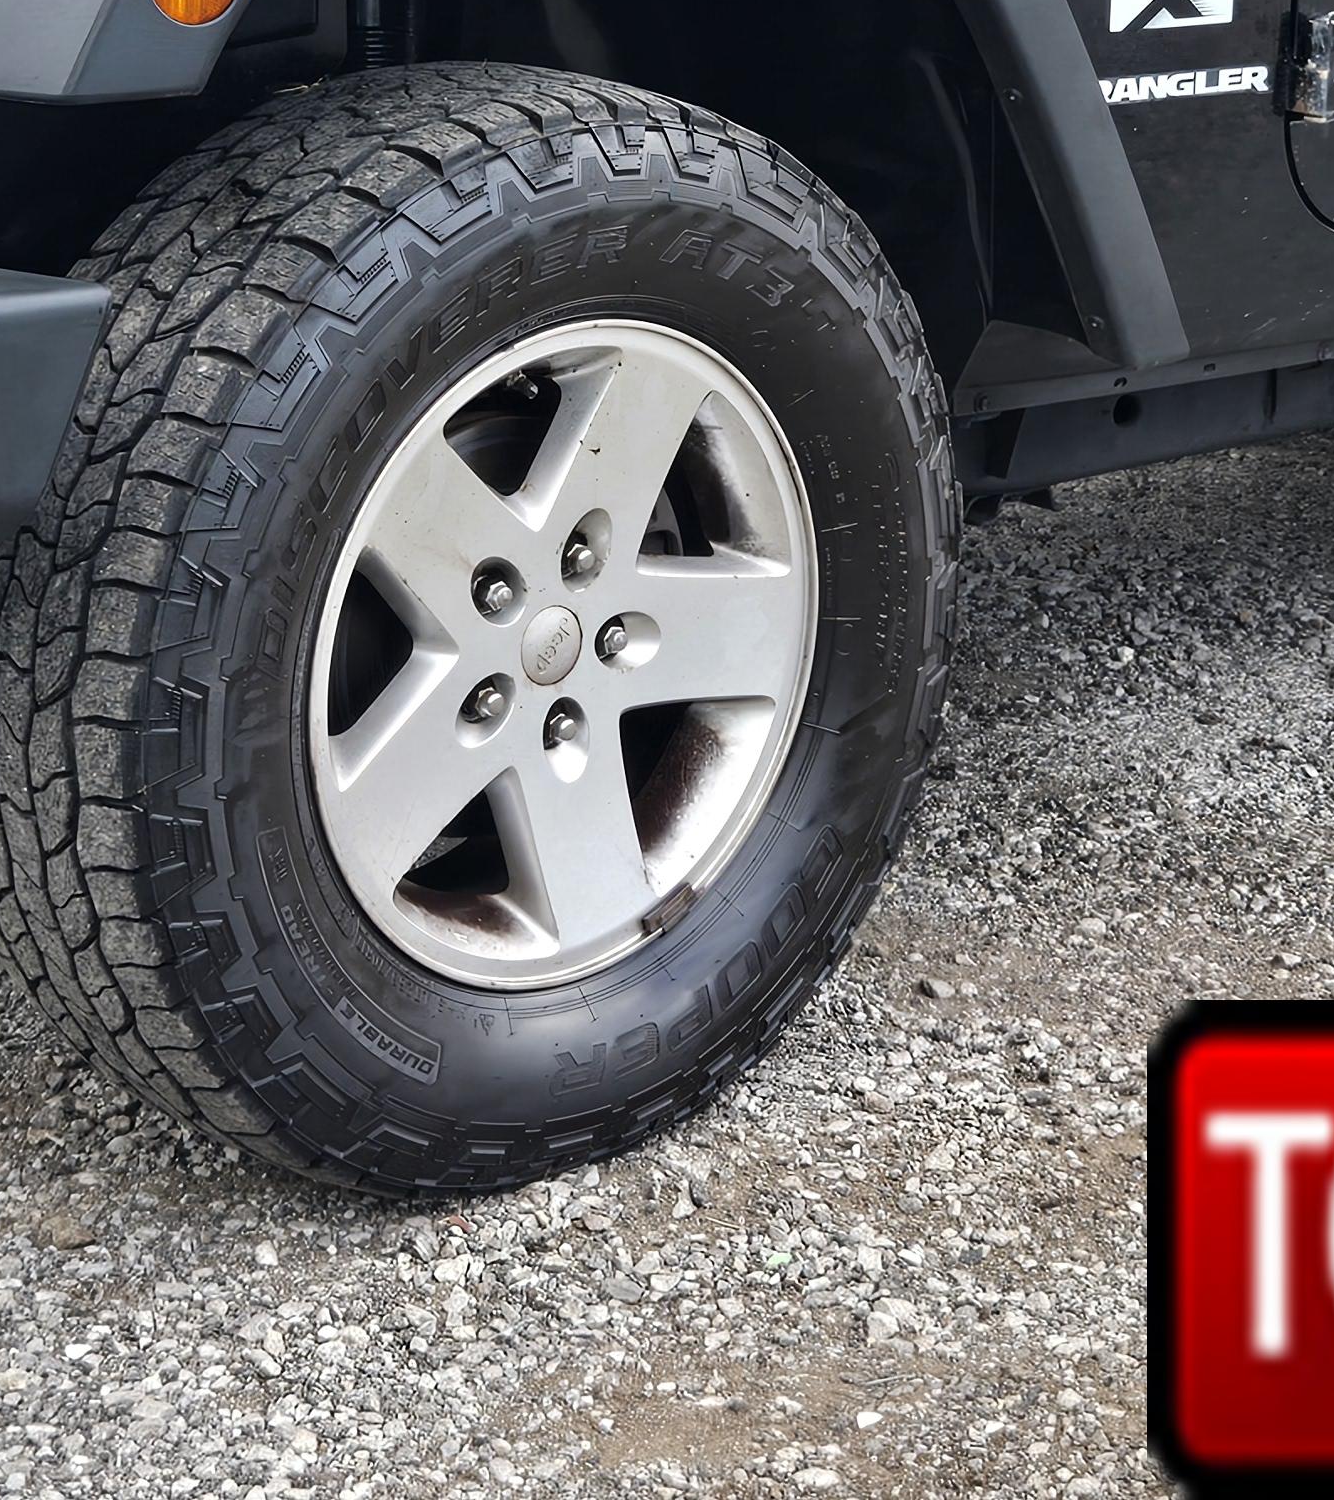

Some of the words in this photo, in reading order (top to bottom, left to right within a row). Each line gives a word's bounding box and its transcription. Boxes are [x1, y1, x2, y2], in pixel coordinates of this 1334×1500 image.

[1098, 66, 1270, 103] RANGLER
[536, 617, 571, 675] Jeep
[549, 824, 843, 1098] COOPER
